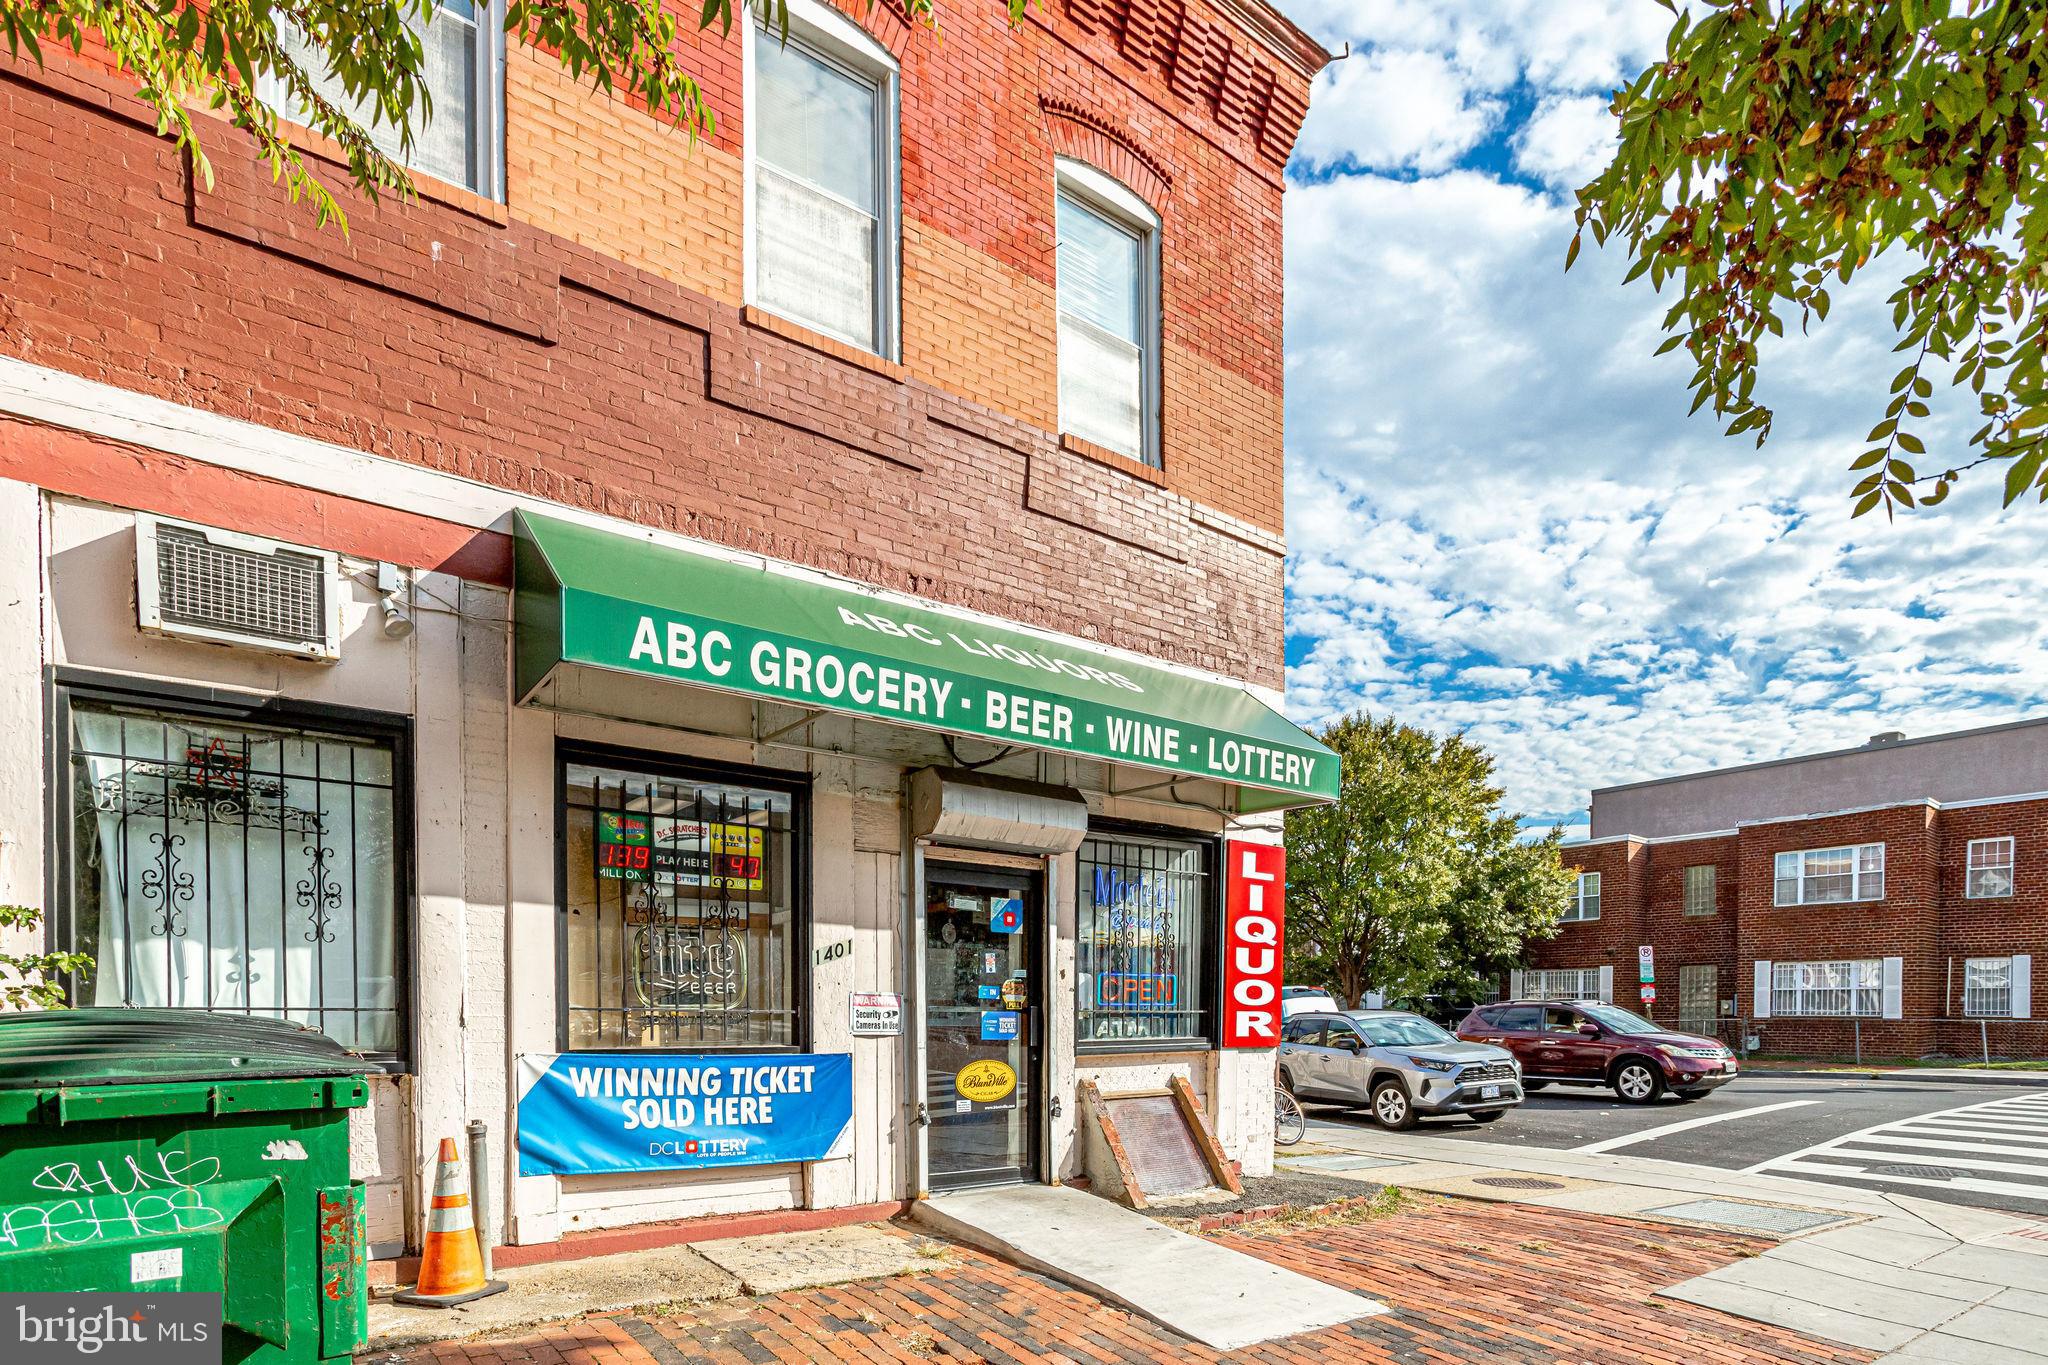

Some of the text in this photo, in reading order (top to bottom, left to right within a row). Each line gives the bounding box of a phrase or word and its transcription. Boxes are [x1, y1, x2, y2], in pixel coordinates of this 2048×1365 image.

[836, 605, 1145, 693] ABC LIQUORS
[629, 616, 1316, 787] ABC GROCERY BEER WINE LOTTERY
[599, 867, 643, 881] MILLON
[816, 939, 852, 965] 1401
[1233, 851, 1277, 1037] LIQUOR
[1102, 977, 1173, 1002] OPEN
[856, 1009, 882, 1020] Security
[856, 1020, 899, 1030] Cameras In Use
[569, 1065, 816, 1098] WINNING TICKET
[623, 1096, 773, 1130] SOLD HERE
